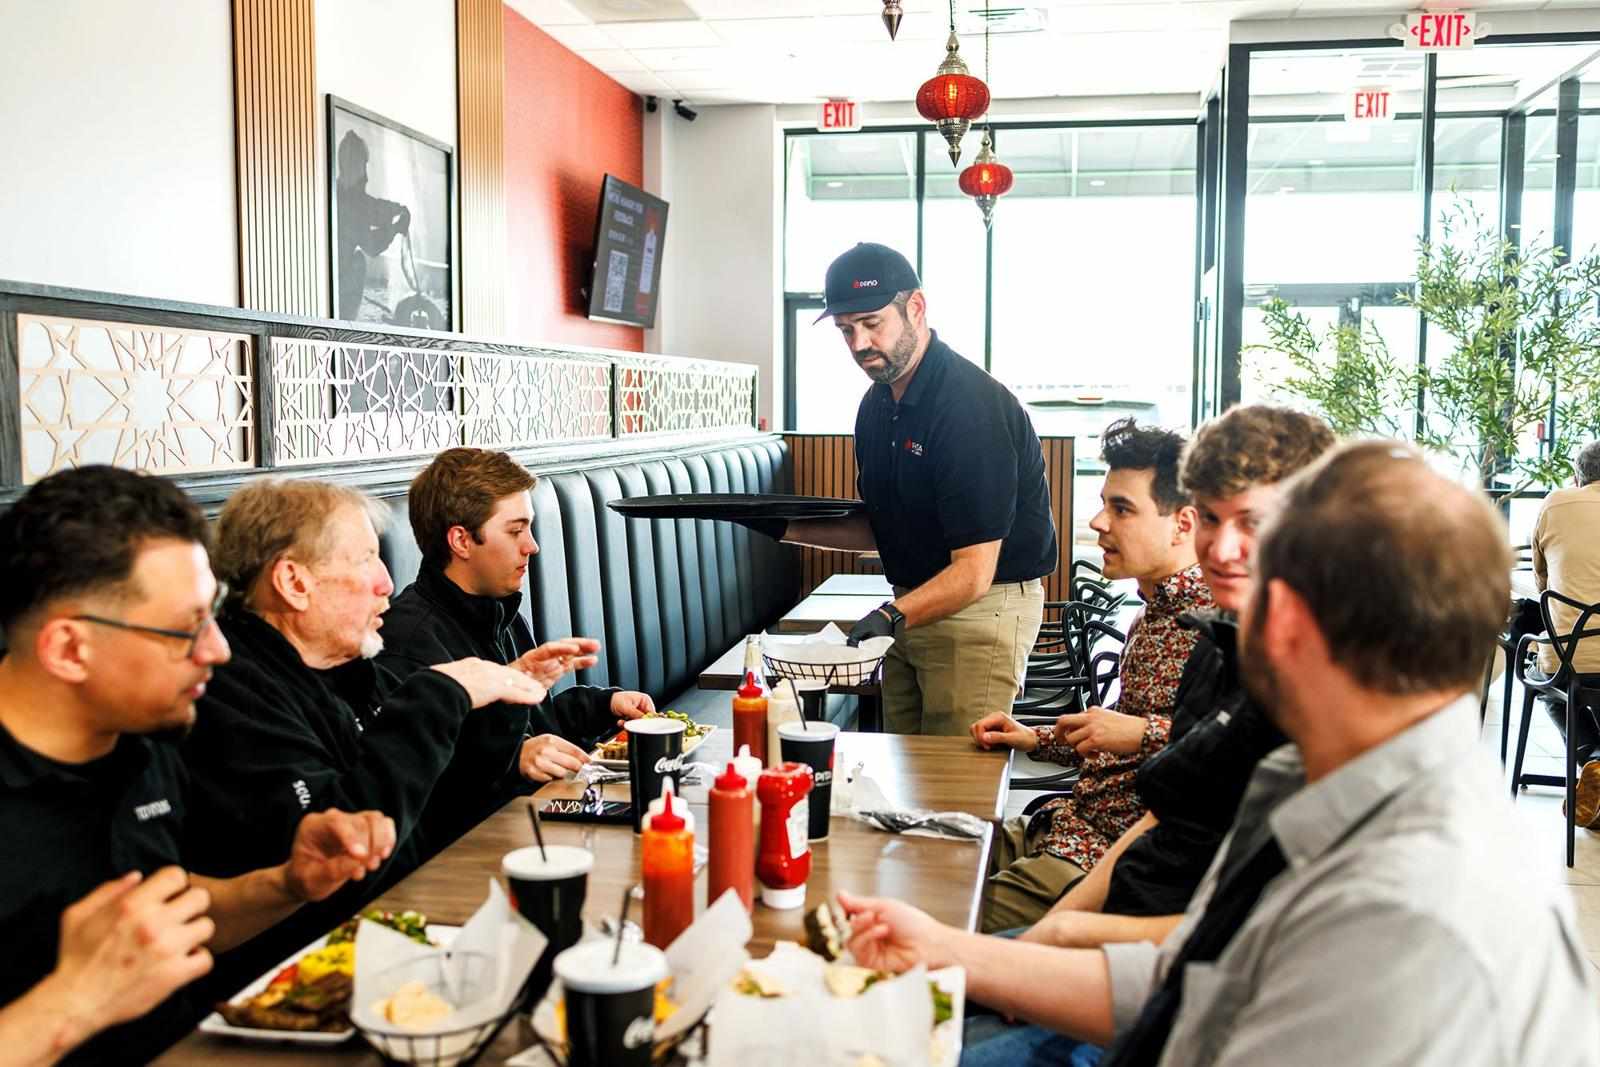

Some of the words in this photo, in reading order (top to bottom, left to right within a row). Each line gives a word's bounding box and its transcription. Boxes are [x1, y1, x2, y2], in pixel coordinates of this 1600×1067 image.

[1420, 15, 1465, 46] EXIT
[823, 102, 855, 128] EXIT
[1355, 92, 1389, 118] EXIT
